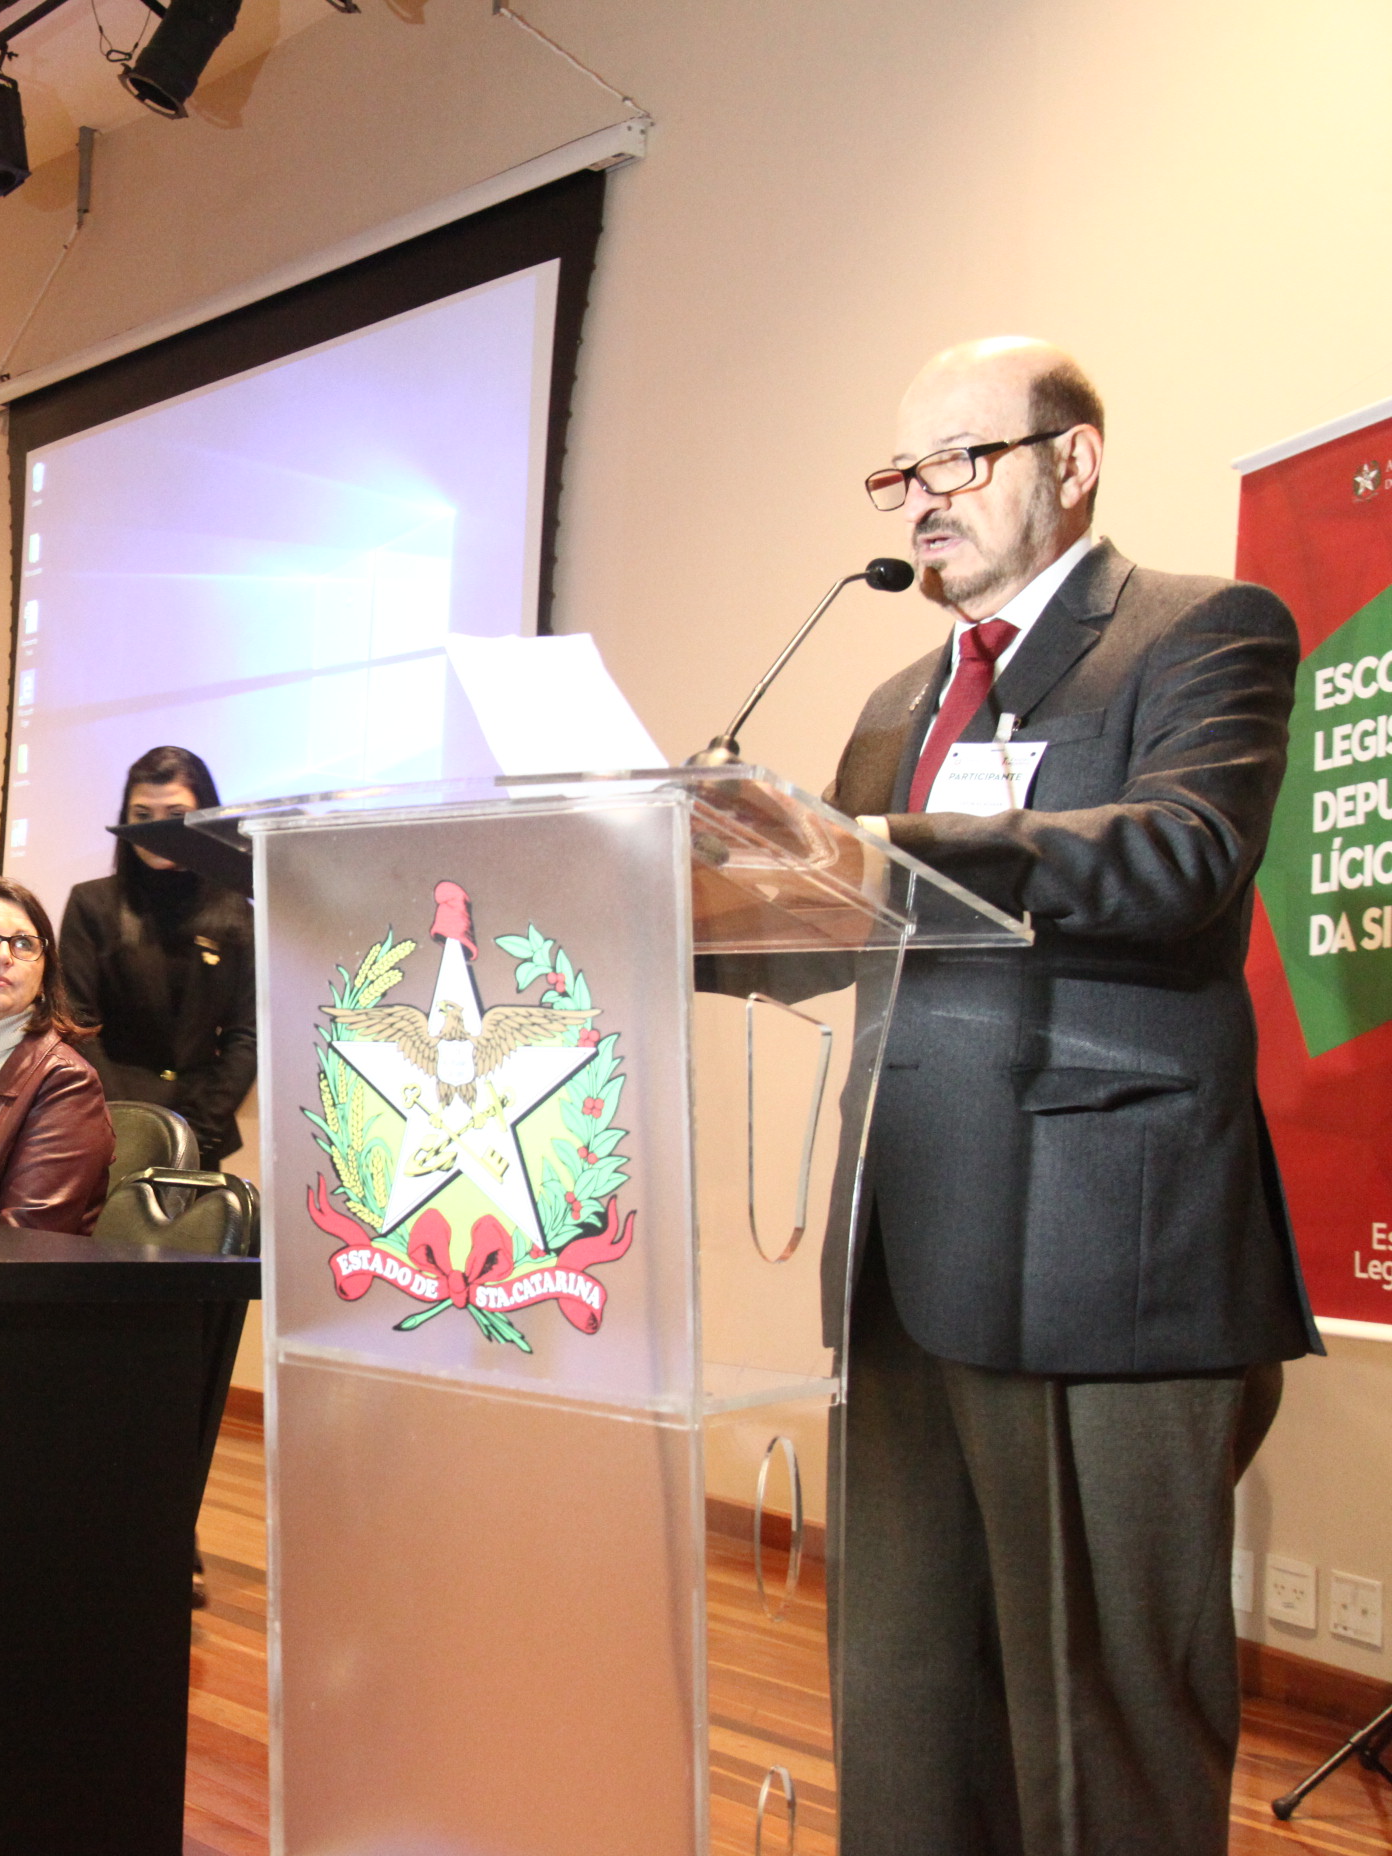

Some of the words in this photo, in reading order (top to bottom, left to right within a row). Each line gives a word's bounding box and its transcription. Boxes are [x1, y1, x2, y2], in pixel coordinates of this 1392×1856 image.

[1313, 714, 1392, 772] LEGI
[948, 772, 1023, 782] PARTICIPANTE
[1308, 911, 1357, 957] DA
[336, 1249, 412, 1286] ESTADO
[409, 1273, 439, 1300] DE
